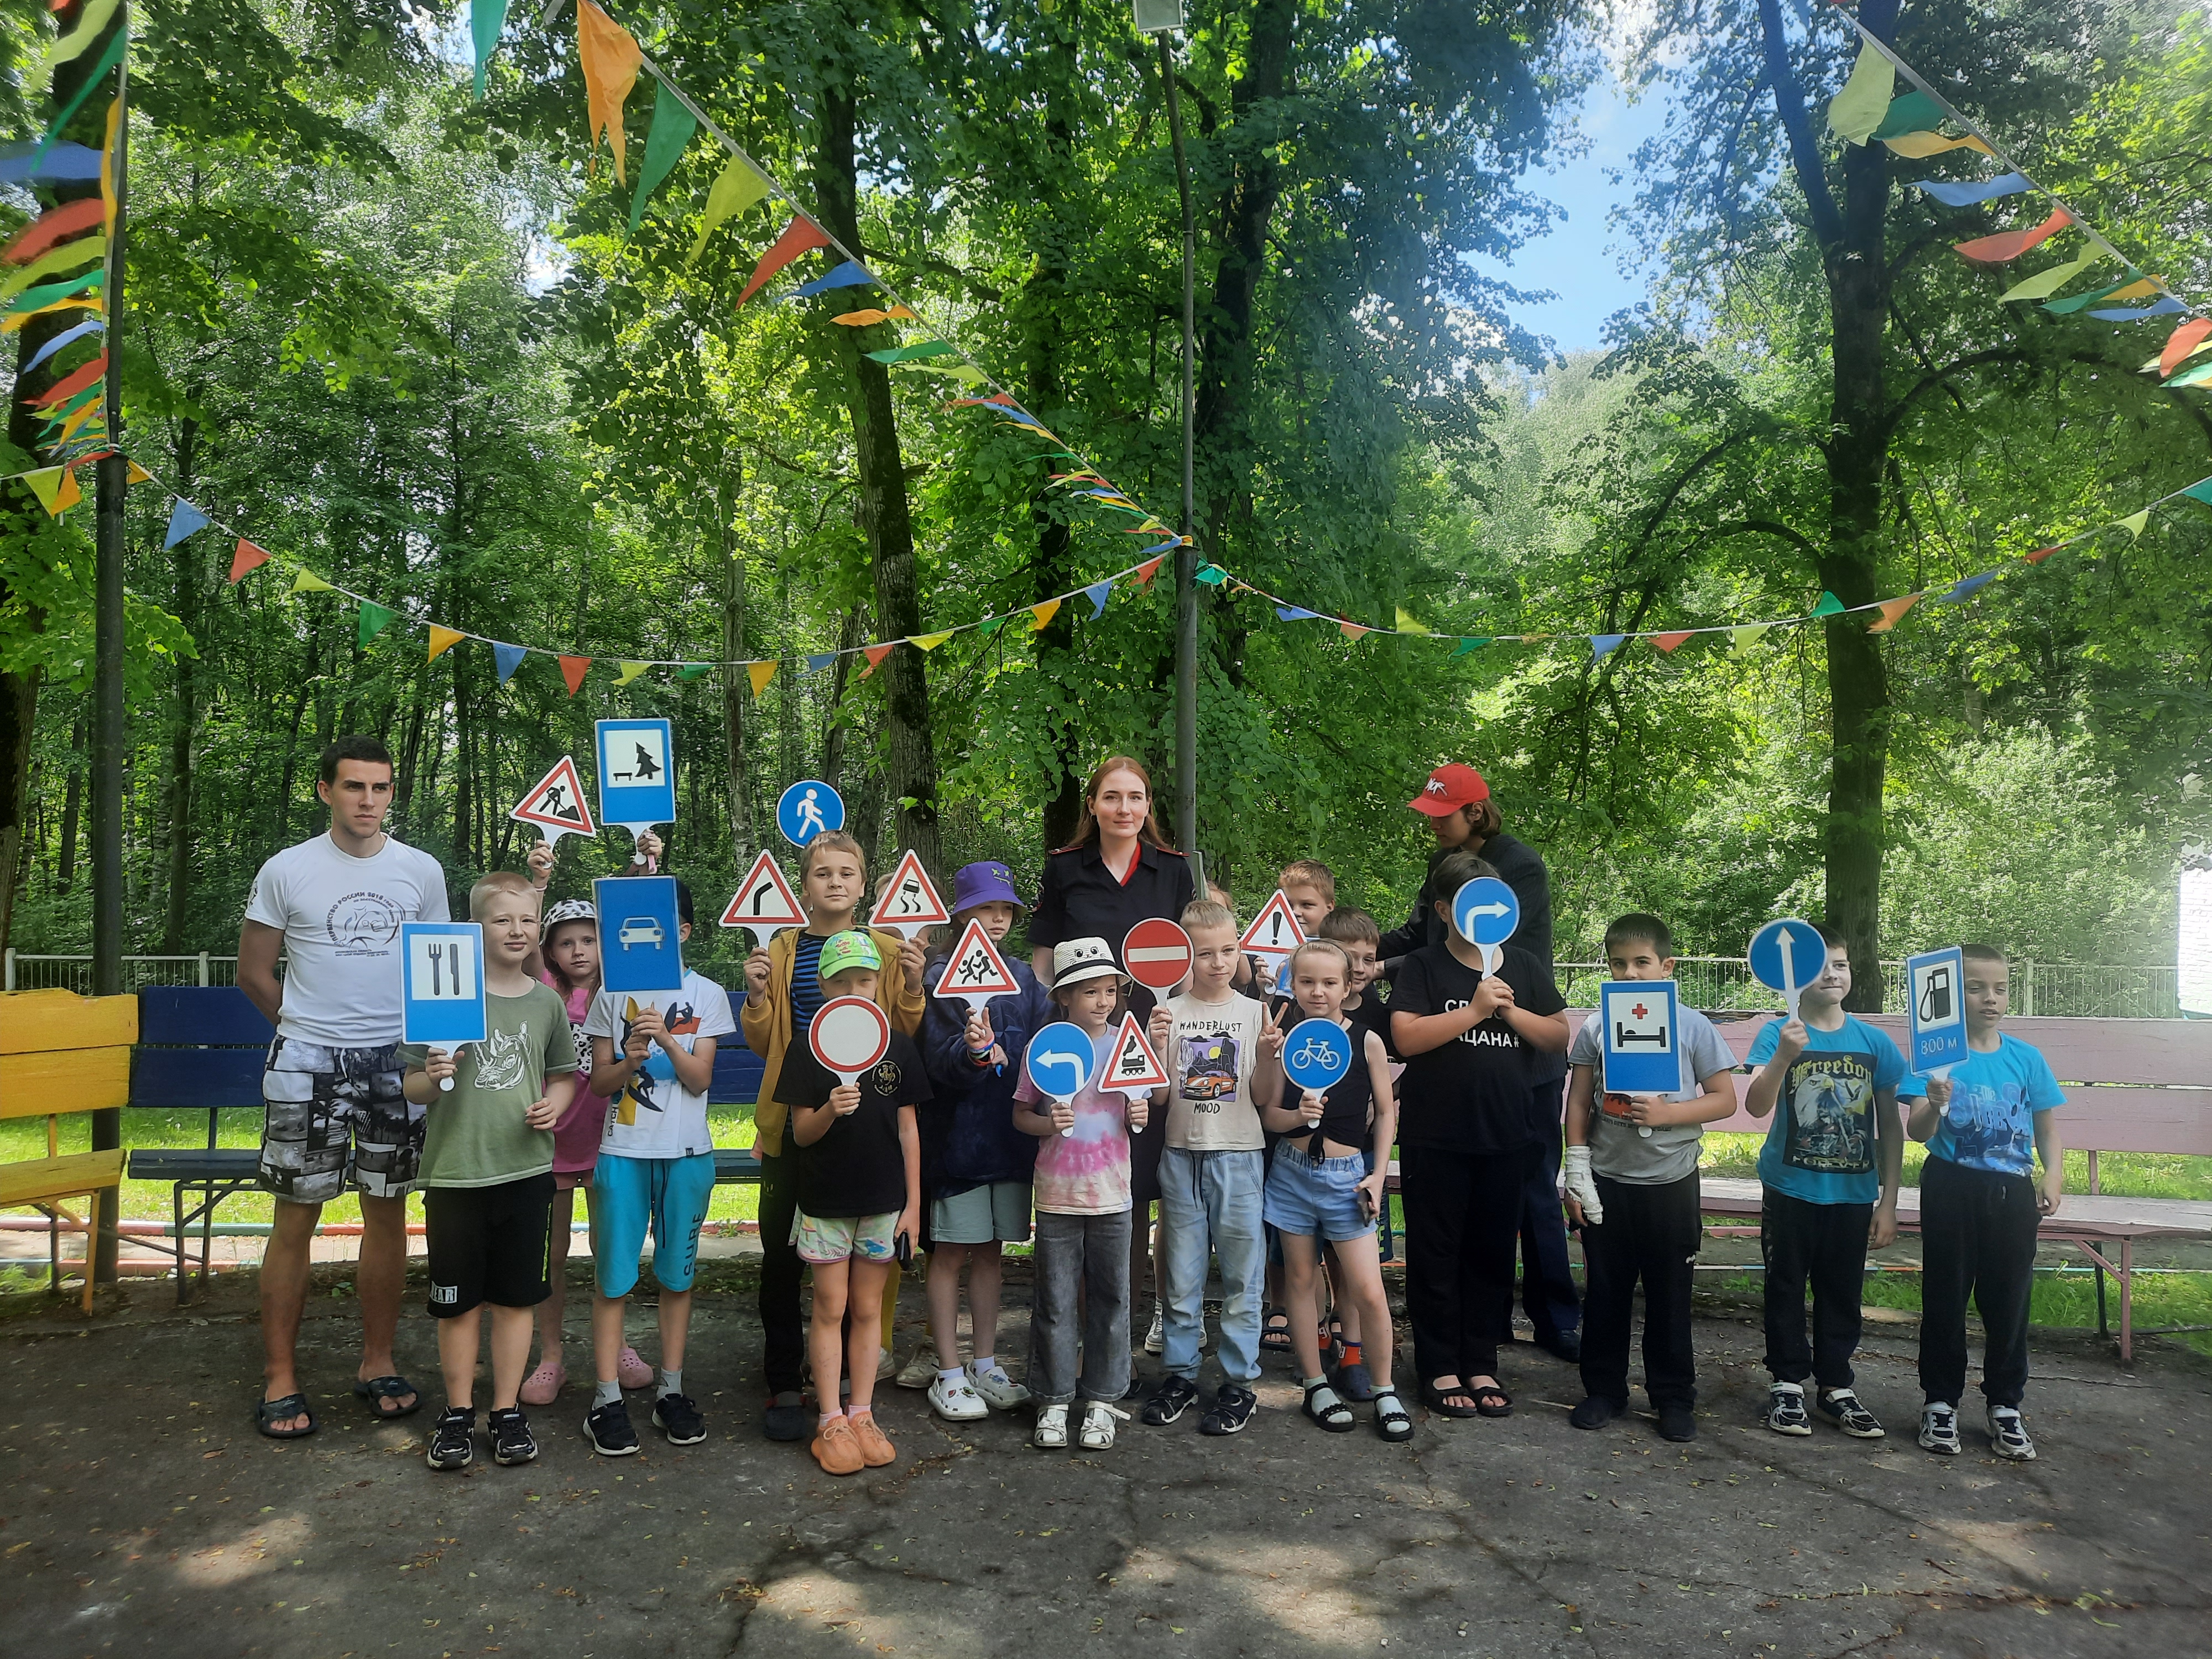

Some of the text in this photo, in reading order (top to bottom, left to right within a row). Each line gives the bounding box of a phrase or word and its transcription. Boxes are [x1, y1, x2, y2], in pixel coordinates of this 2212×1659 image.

[326, 904, 338, 942] ПЕРВЕНСТВО
[338, 891, 365, 905] РОССИИ
[1180, 1020, 1243, 1032] WANDERLUST
[1921, 1036, 1944, 1055] 800
[1194, 1103, 1220, 1114] MOOD
[608, 1107, 619, 1136] CATCH
[684, 1213, 702, 1276] SURF
